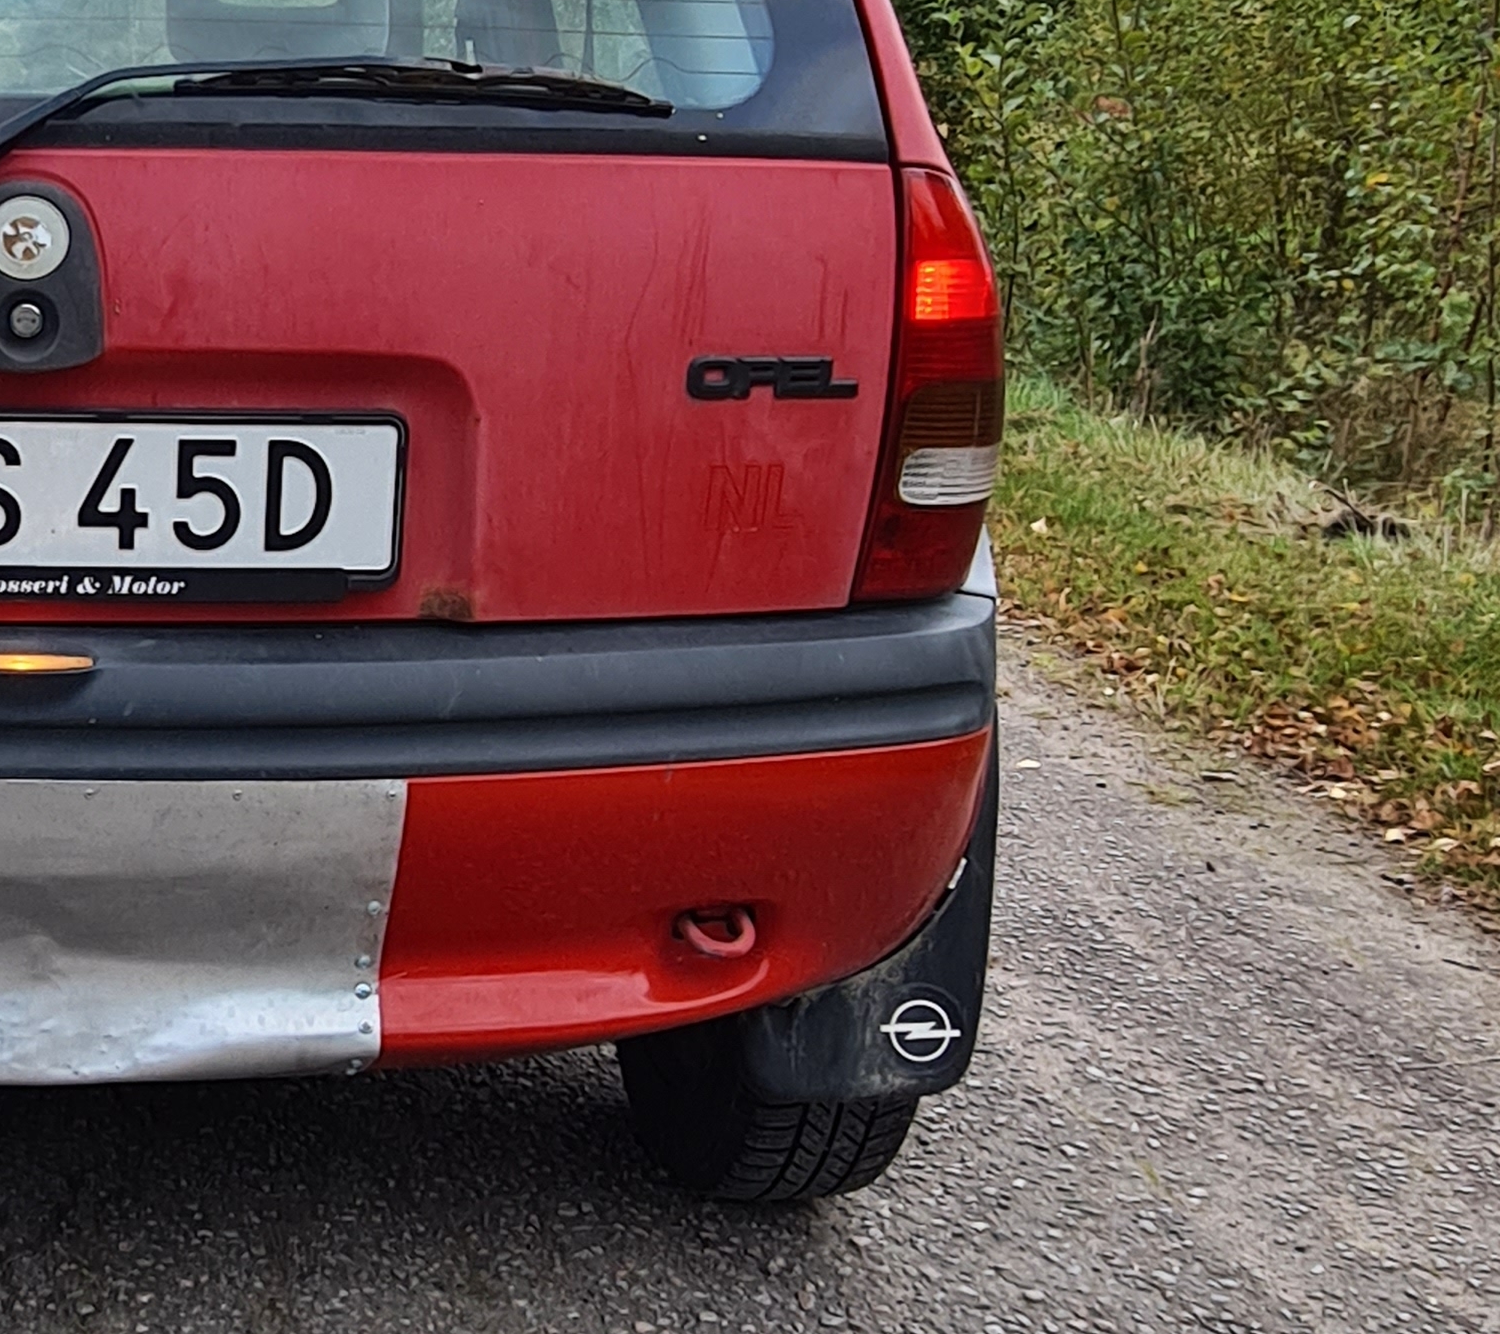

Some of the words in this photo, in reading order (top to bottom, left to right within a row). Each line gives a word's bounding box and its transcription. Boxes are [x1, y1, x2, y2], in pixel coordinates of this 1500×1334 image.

[686, 355, 859, 401] OPEL
[76, 437, 333, 552] 45D
[76, 575, 101, 595] &
[106, 574, 186, 595] Motor
